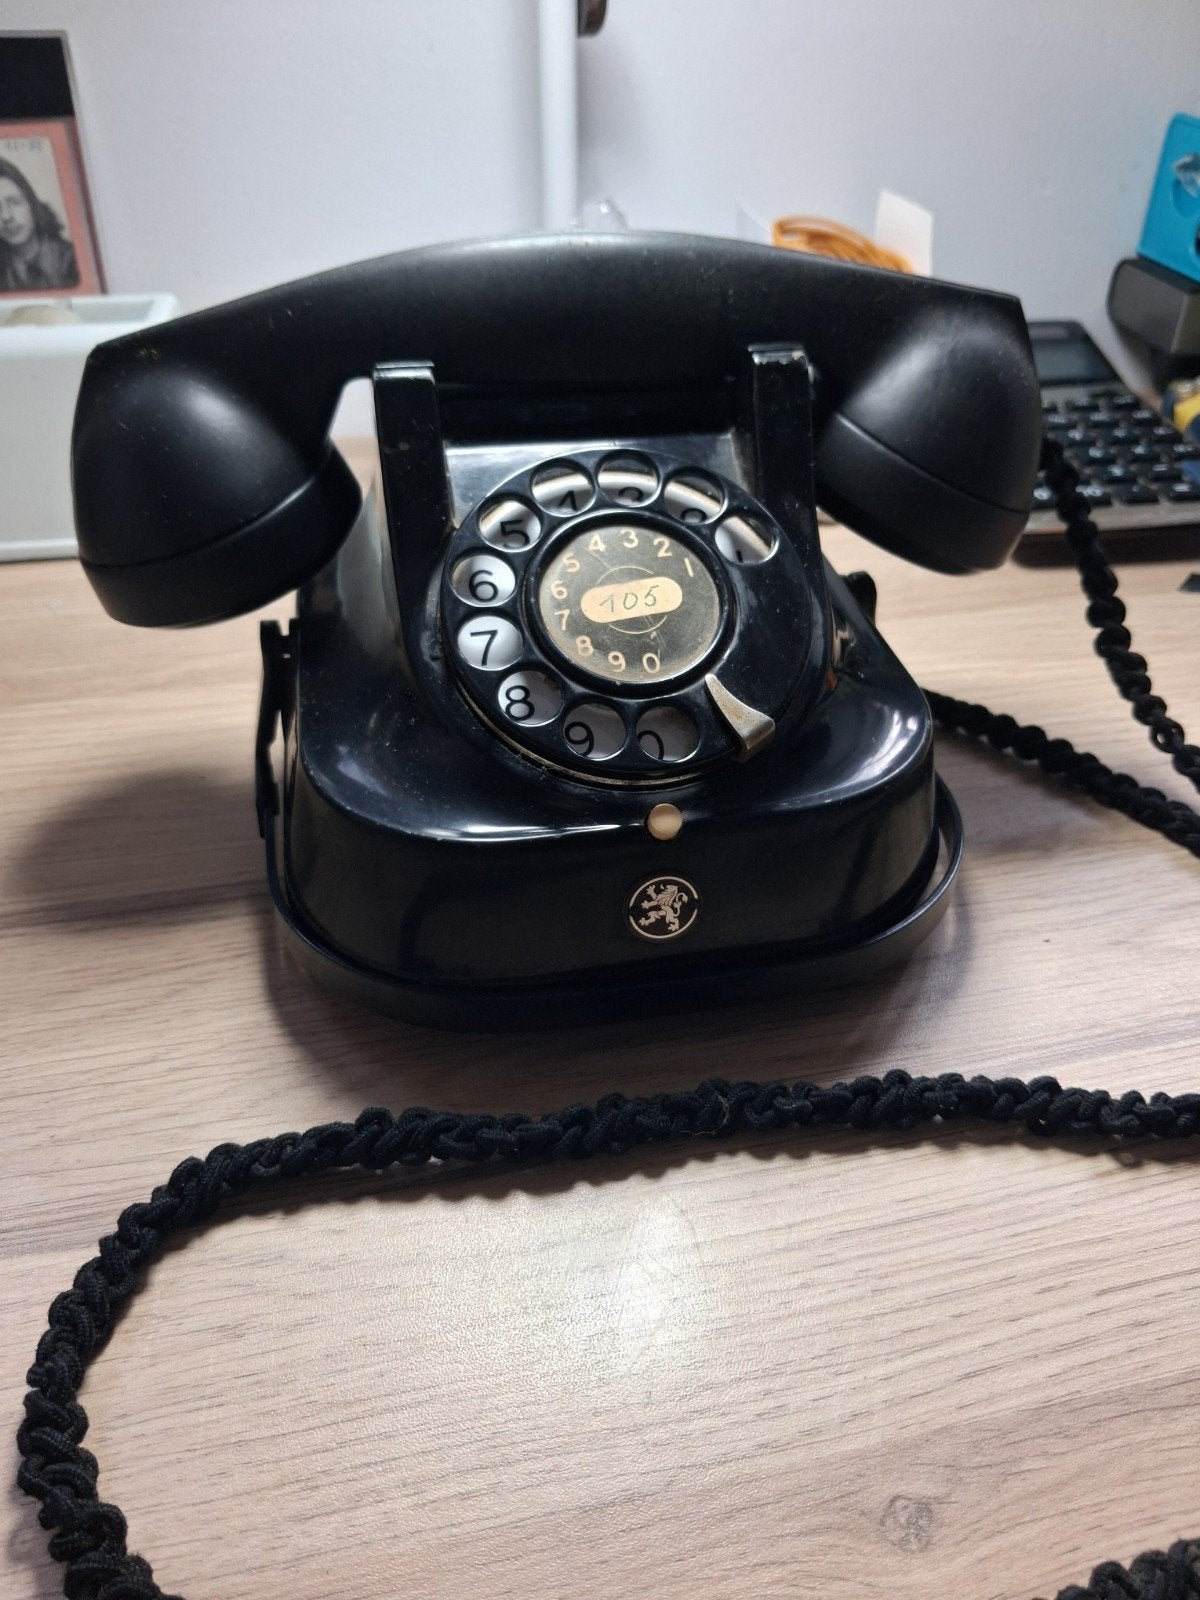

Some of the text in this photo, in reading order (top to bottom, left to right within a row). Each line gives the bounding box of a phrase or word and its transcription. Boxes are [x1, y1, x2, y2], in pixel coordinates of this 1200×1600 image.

[499, 520, 530, 549] 5
[588, 533, 606, 552] 4
[620, 528, 639, 548] 3
[653, 537, 672, 557] 2
[562, 552, 581, 572] 5
[684, 558, 694, 577] 1
[468, 569, 499, 603] 6
[551, 580, 568, 600] 6
[598, 585, 660, 613] 105
[554, 609, 571, 631] 7
[470, 629, 499, 667] 7
[576, 635, 594, 656] 8
[608, 651, 626, 672] 9
[642, 653, 661, 674] 0
[505, 684, 535, 722] 8
[564, 721, 595, 757] 9
